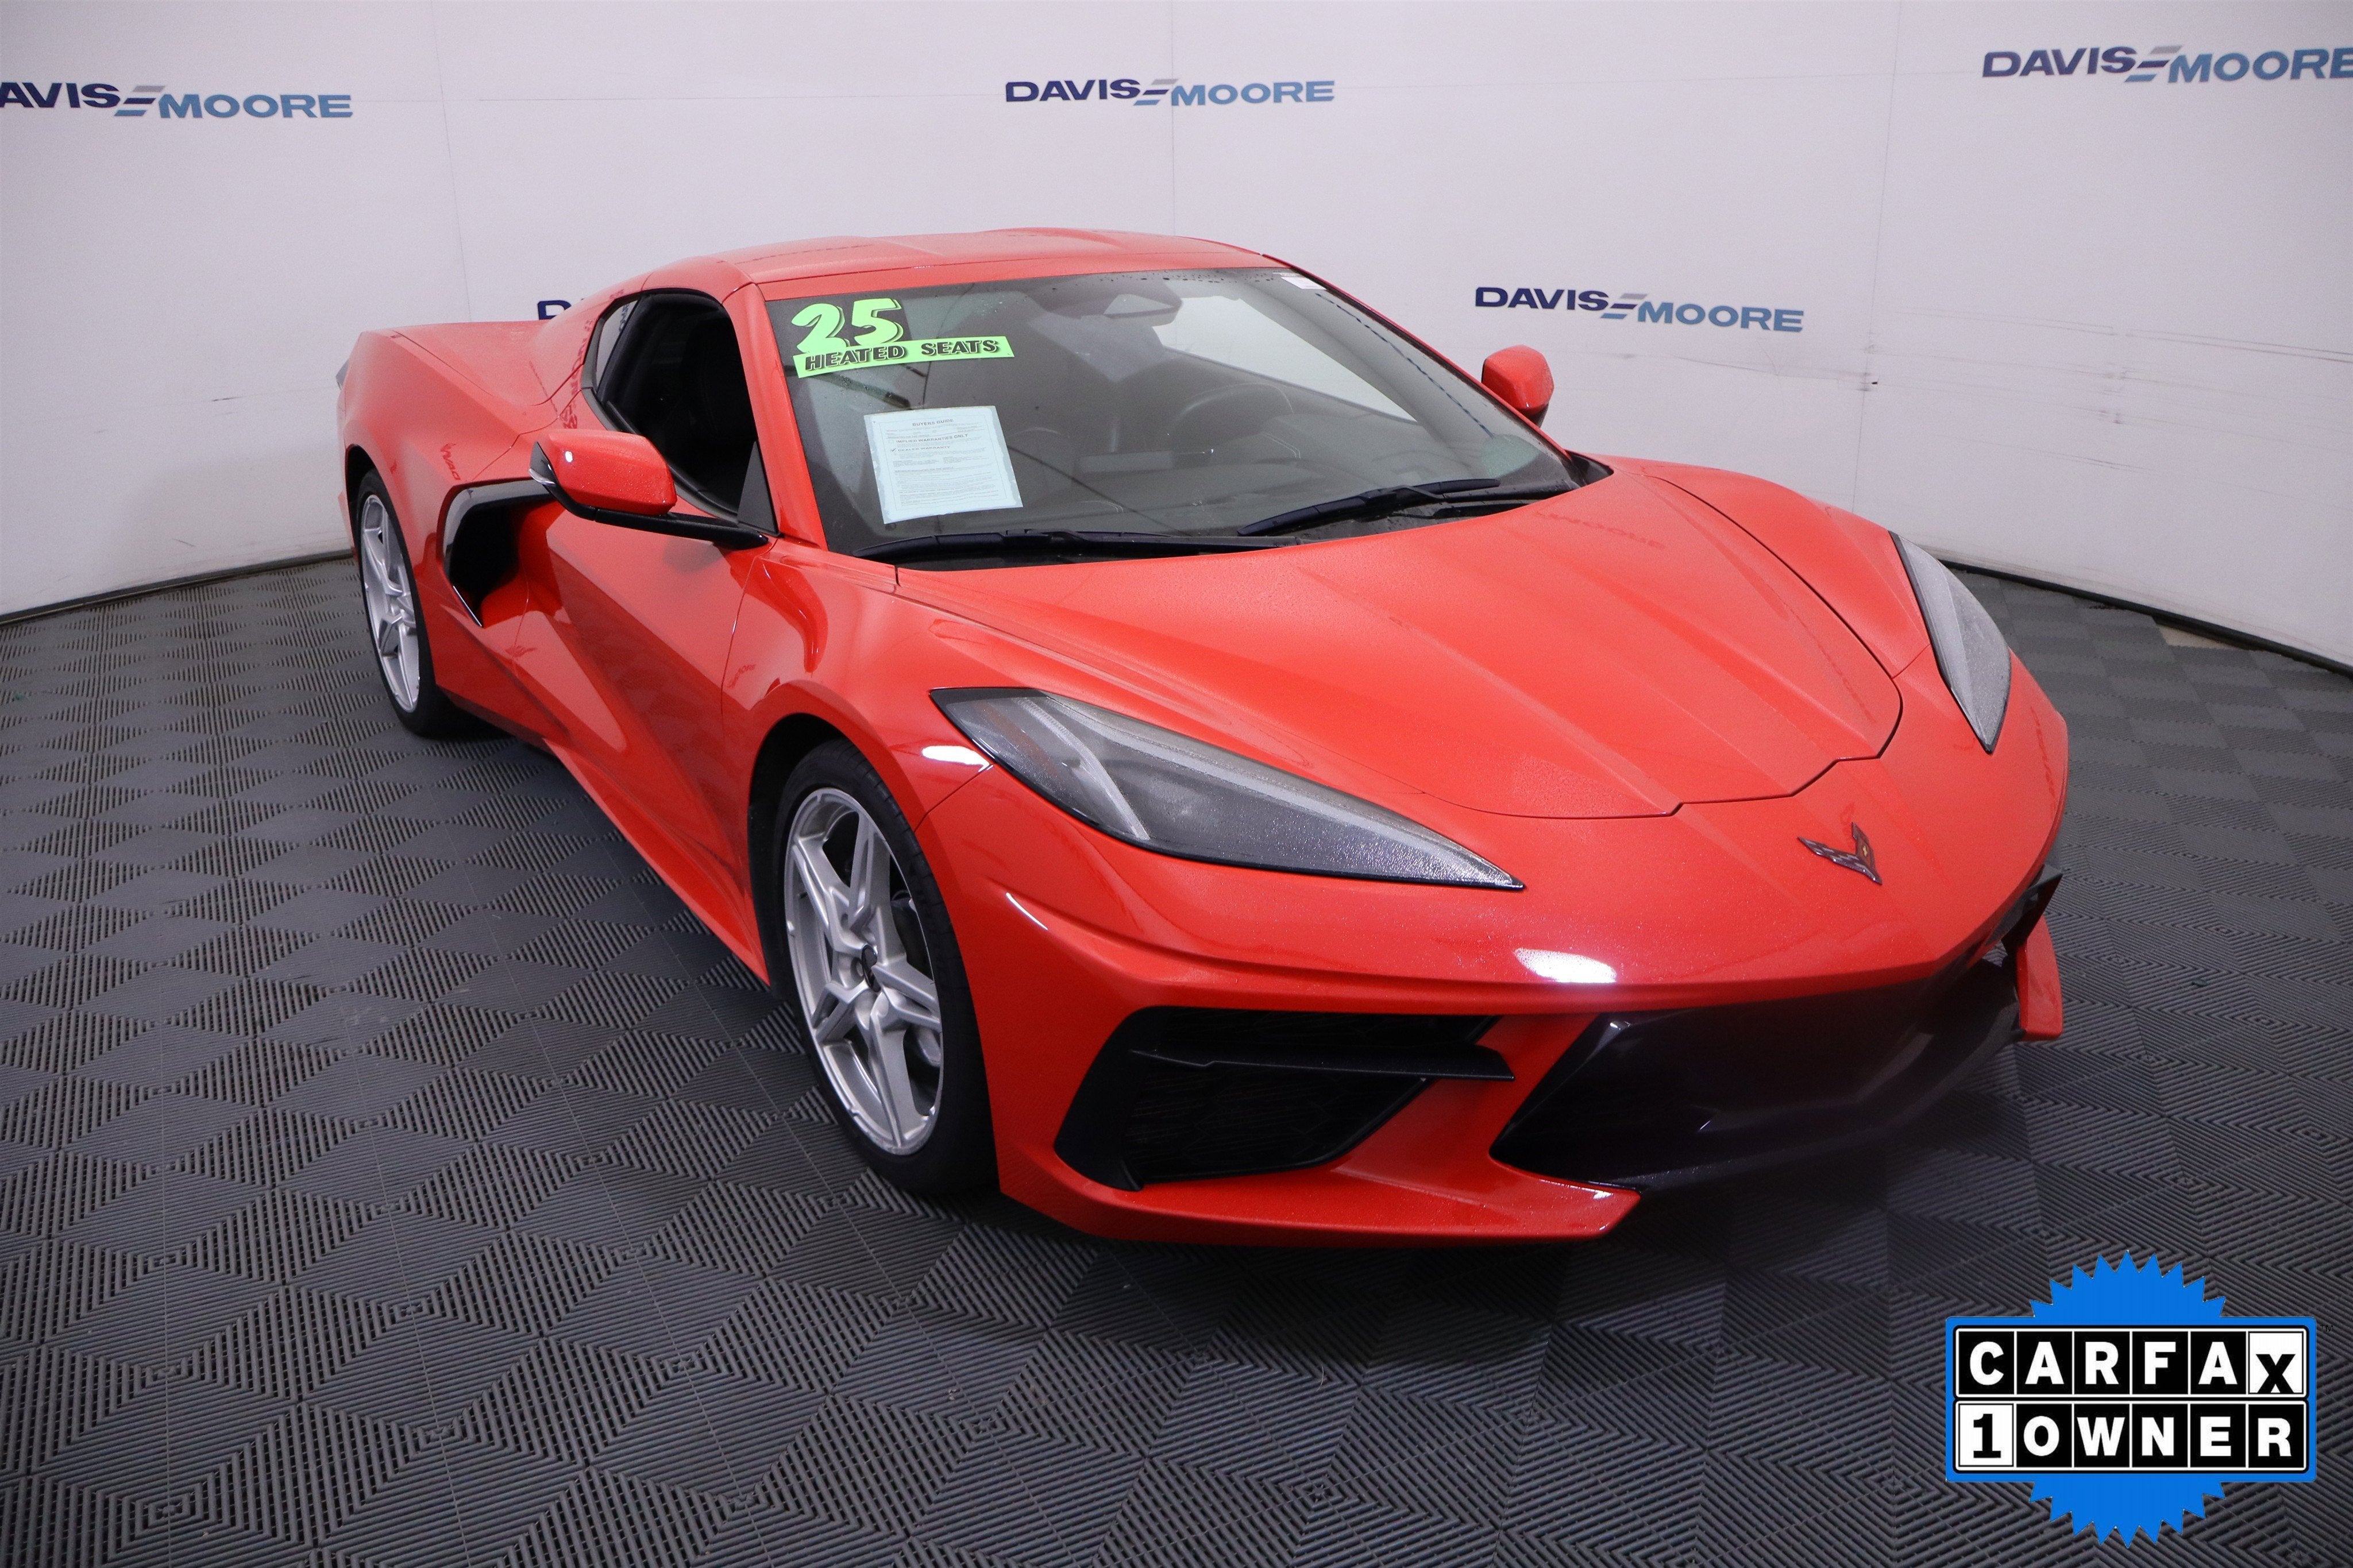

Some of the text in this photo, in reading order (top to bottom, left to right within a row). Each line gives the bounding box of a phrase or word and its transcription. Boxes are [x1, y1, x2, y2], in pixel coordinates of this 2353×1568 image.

[1983, 46, 2353, 83] DAVIS MOORE
[159, 94, 353, 118] MOORE
[1005, 79, 1334, 106] DAVIS MOORE
[791, 298, 904, 354] 25
[1475, 287, 1804, 332] DAVIS MOORE
[805, 339, 1000, 372] HEATED SEATS
